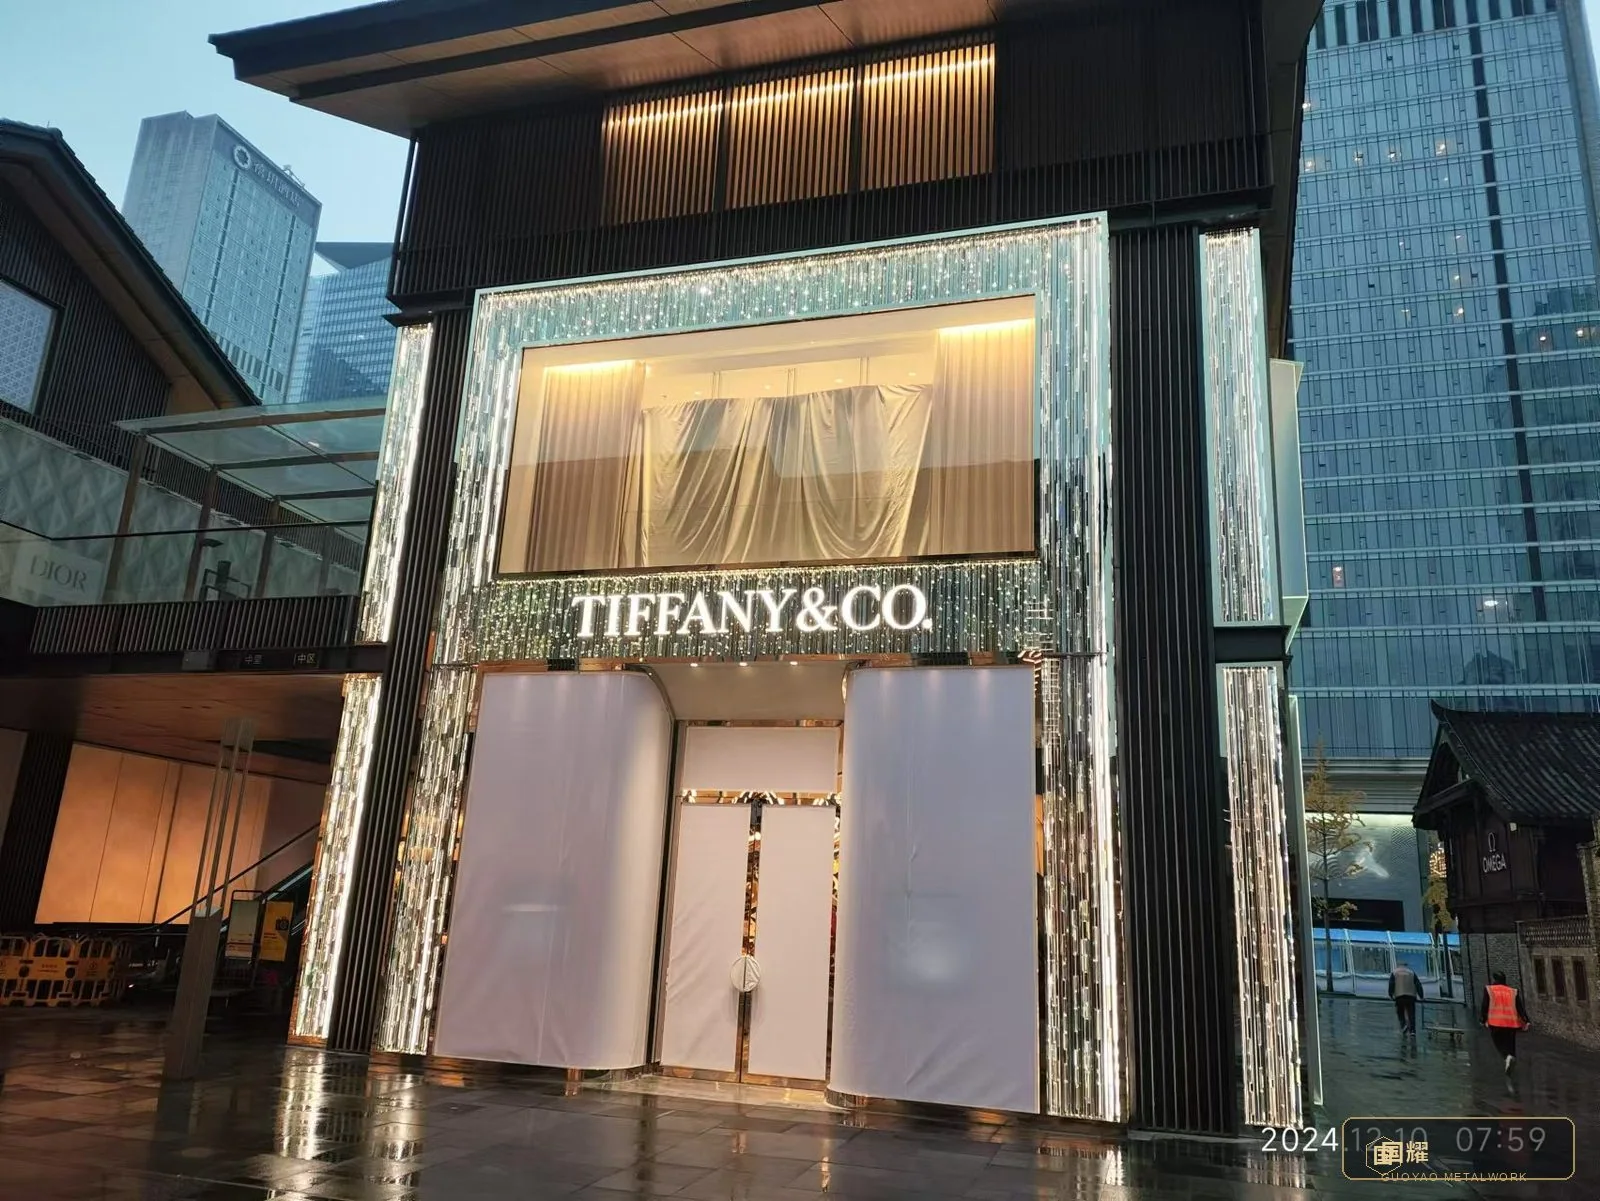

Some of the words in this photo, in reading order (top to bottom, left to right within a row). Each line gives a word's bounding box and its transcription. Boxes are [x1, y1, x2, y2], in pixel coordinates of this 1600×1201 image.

[30, 555, 87, 593] DIOR
[571, 584, 933, 638] TIFFANY&CO.
[1482, 853, 1507, 873] OMEGA
